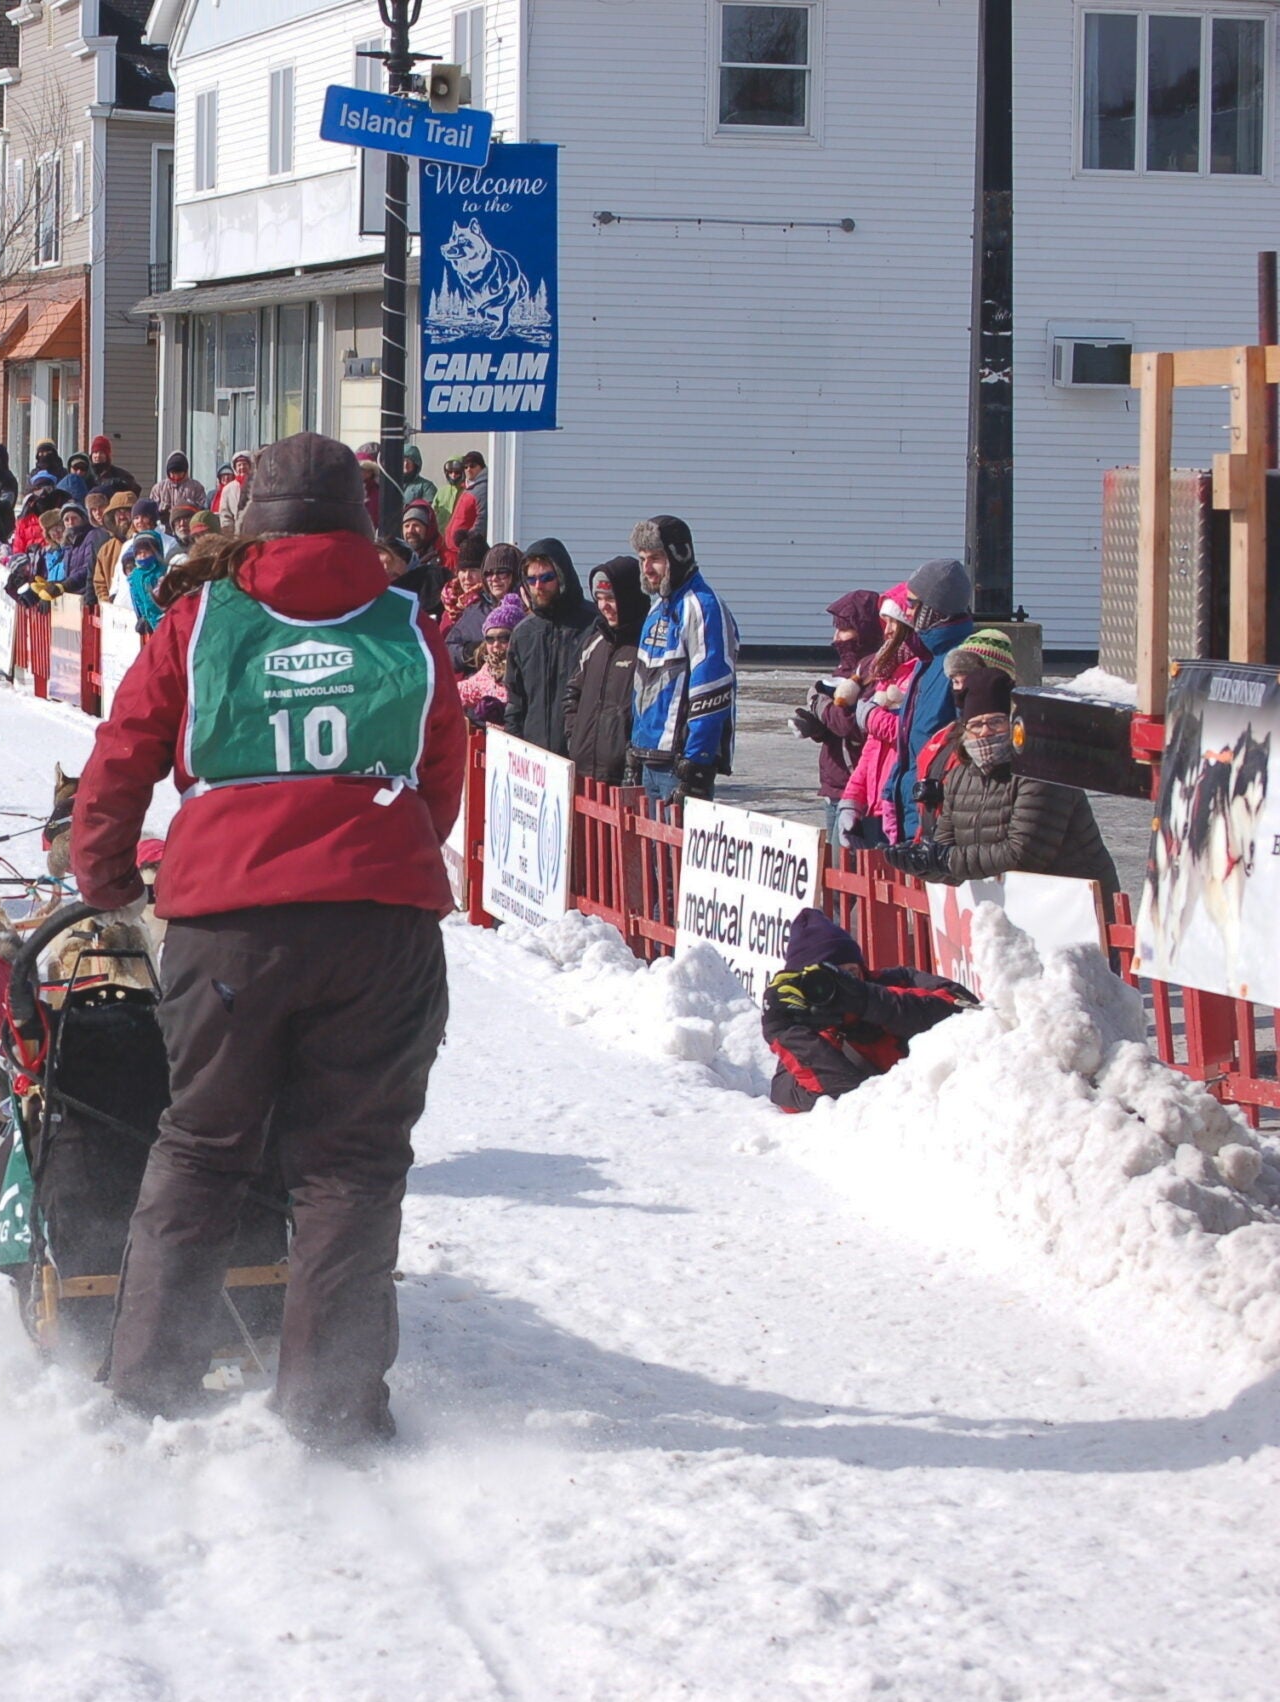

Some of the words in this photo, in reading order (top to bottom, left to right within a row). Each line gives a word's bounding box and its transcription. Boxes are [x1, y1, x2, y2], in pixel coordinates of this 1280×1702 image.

[339, 103, 414, 138] Island
[424, 118, 473, 148] Trail
[425, 162, 547, 195] Welcome
[462, 199, 480, 213] to
[484, 196, 513, 213] the
[424, 353, 550, 381] CAN-AM
[428, 384, 546, 412] CROWN
[264, 652, 354, 671] IRVING
[263, 689, 293, 699] MAINE
[294, 685, 355, 697] WOODLANDS
[269, 705, 348, 773] 10
[508, 752, 530, 782] THANK
[532, 761, 546, 789] YOU
[519, 855, 528, 874] THE
[686, 820, 754, 881] northern
[758, 838, 809, 900] maine
[684, 887, 745, 947] medical
[748, 907, 792, 961] cente
